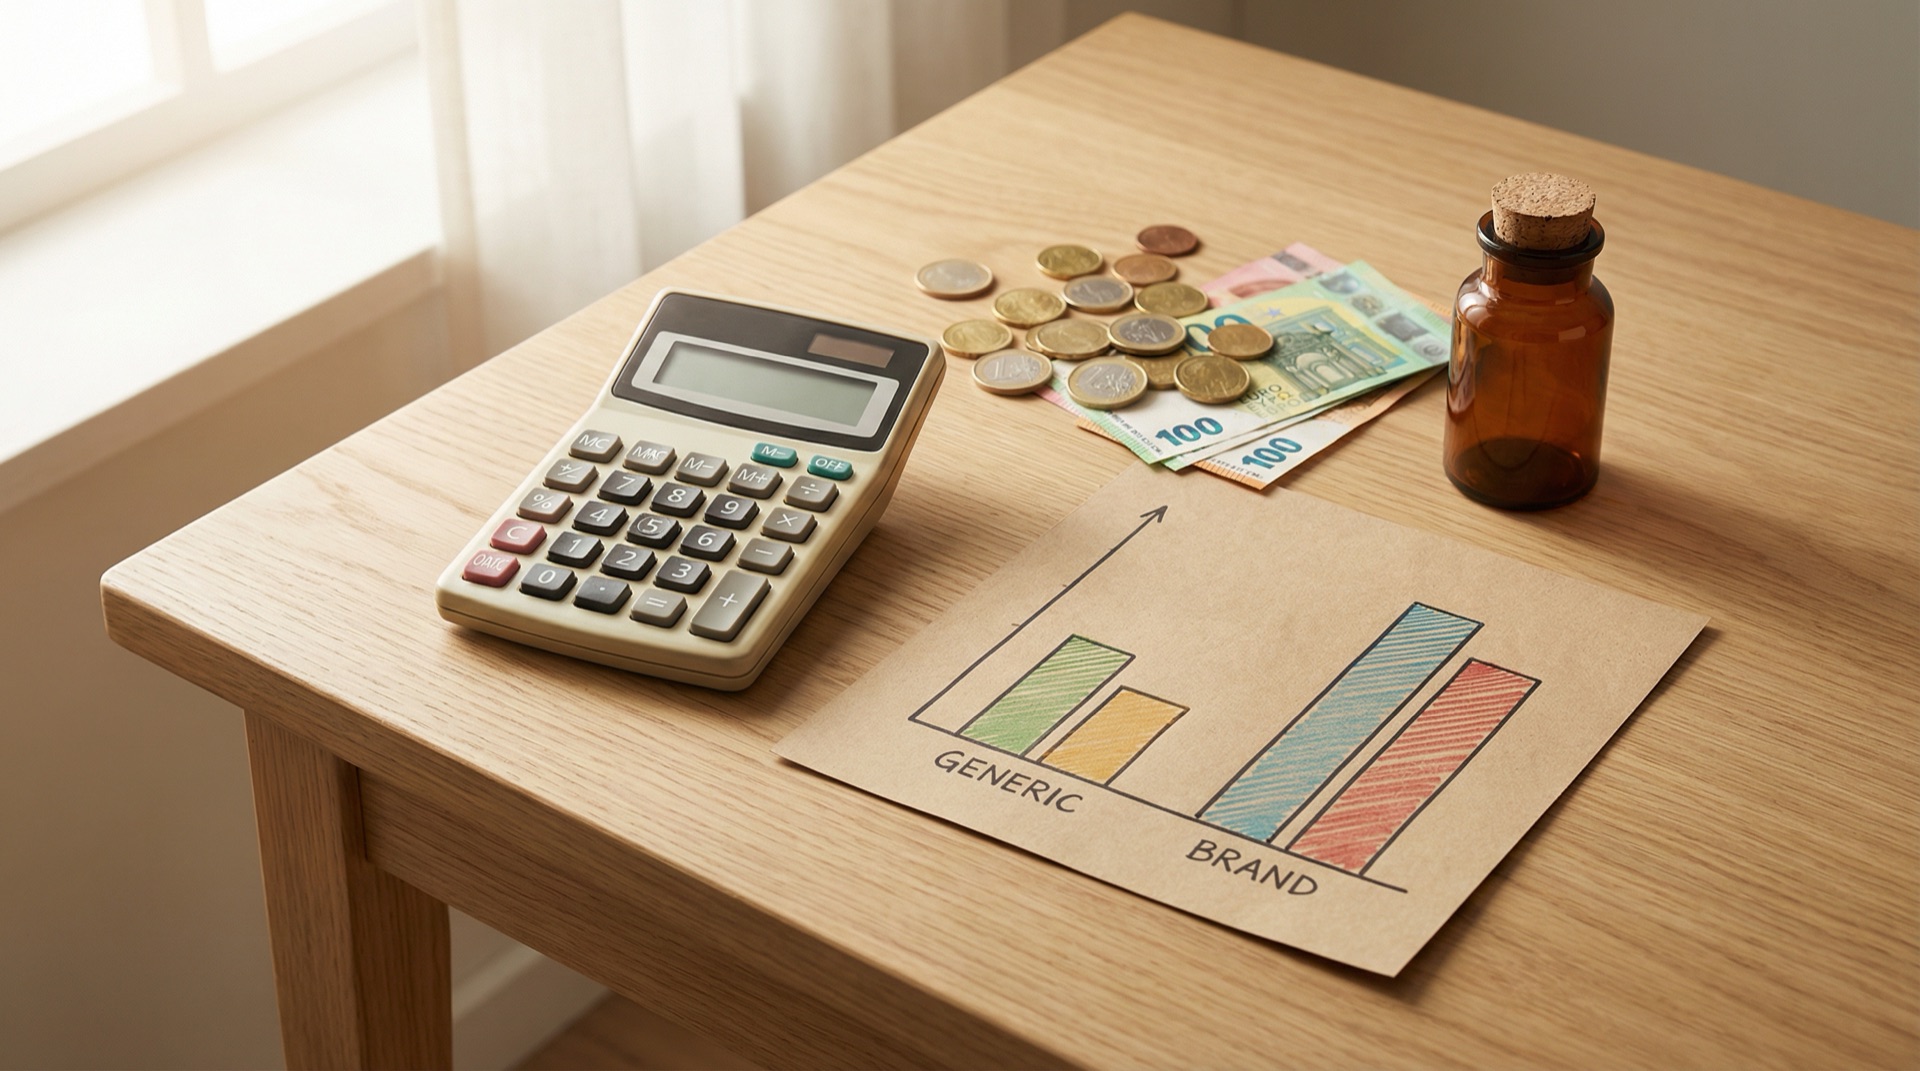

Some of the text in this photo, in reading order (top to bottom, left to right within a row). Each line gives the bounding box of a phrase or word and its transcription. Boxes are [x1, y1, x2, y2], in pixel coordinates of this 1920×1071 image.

[1155, 416, 1224, 447] 100
[579, 434, 609, 449] MC
[1242, 437, 1303, 470] 100
[684, 457, 714, 471] M-
[815, 458, 847, 471] OFF
[616, 475, 636, 490] 7
[737, 468, 769, 483] M+
[533, 494, 553, 509] %
[667, 488, 687, 503] 8
[590, 508, 608, 522] 4
[720, 501, 740, 515] 9
[506, 525, 528, 539] C
[642, 518, 663, 533] 5
[568, 538, 582, 553] 1
[697, 532, 716, 547] 6
[616, 551, 637, 566] 2
[538, 569, 556, 584] 0
[671, 563, 692, 578] 3
[933, 748, 1084, 814] GENERIC
[1185, 838, 1318, 897] BRAND
